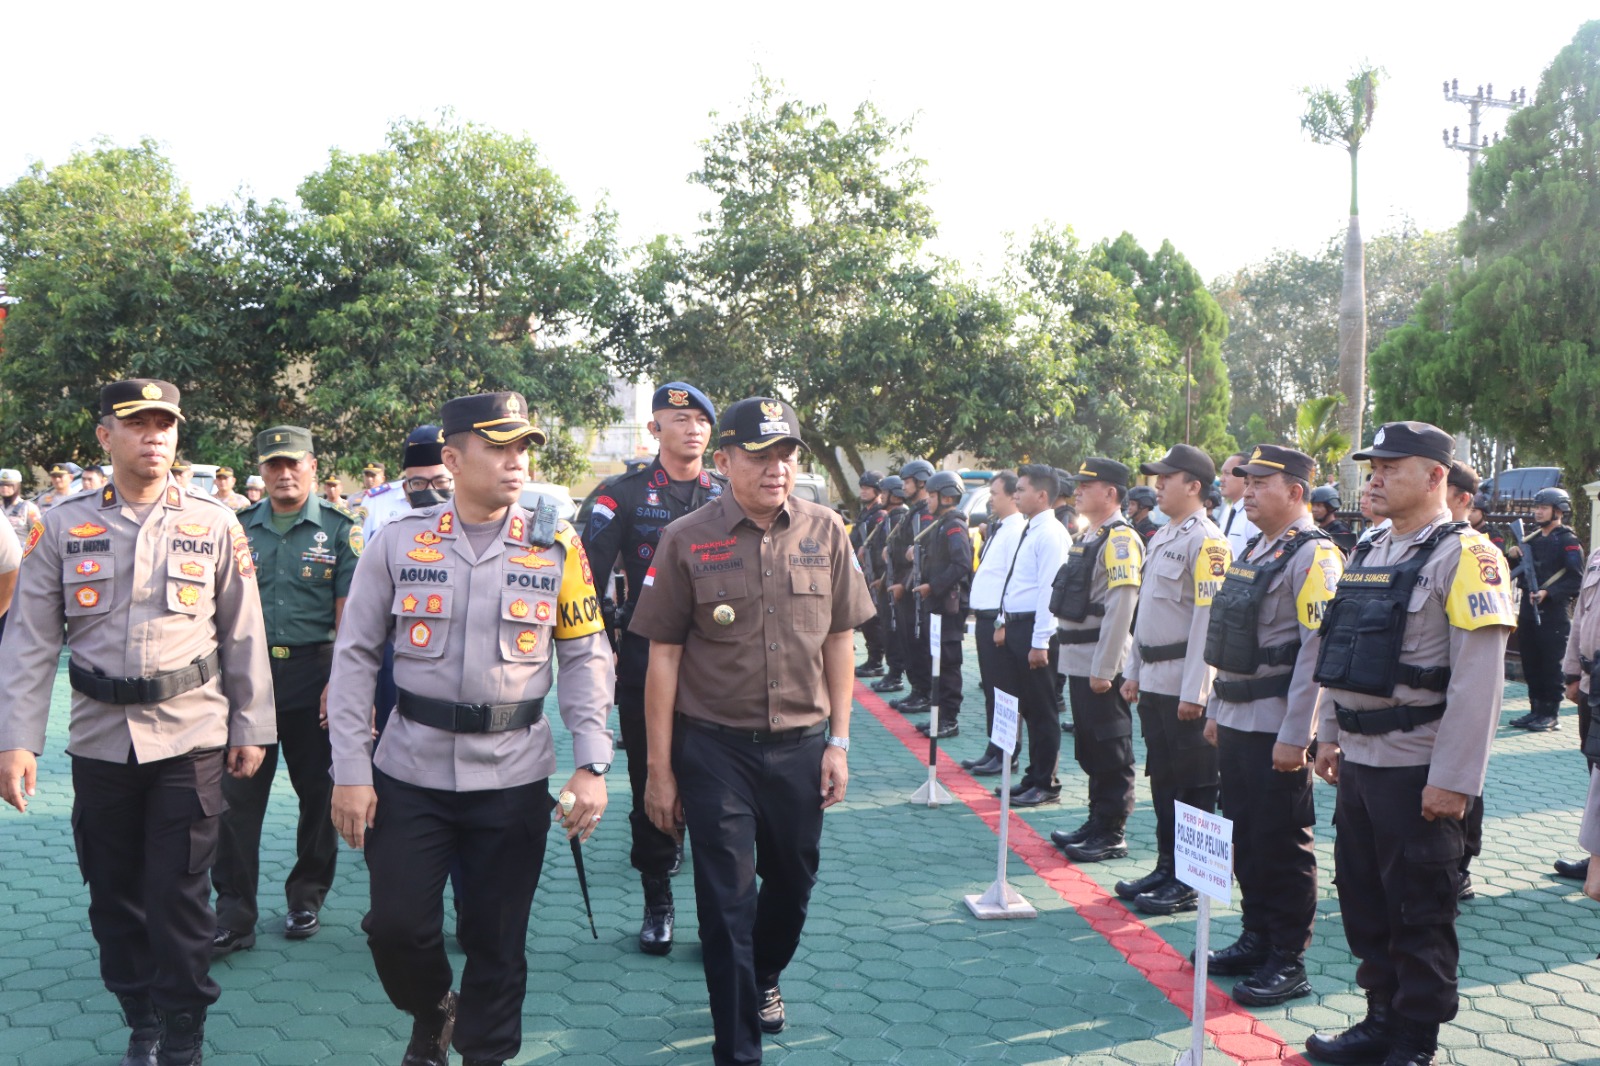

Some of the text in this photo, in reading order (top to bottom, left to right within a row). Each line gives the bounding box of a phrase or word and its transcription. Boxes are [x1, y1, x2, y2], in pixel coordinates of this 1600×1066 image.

[636, 507, 671, 519] SANDI
[172, 539, 214, 555] POLRI
[400, 568, 448, 583] AGUNG
[507, 573, 556, 591] POLRI
[1342, 573, 1391, 583] POLDA SUMSEL
[560, 600, 584, 628] KA
[1183, 812, 1221, 835] PERS PAM TPS
[1177, 822, 1196, 846] POLSEK
[1187, 863, 1205, 879] JUMLAH
[1208, 873, 1213, 882] 9
[1213, 875, 1227, 889] PERS
